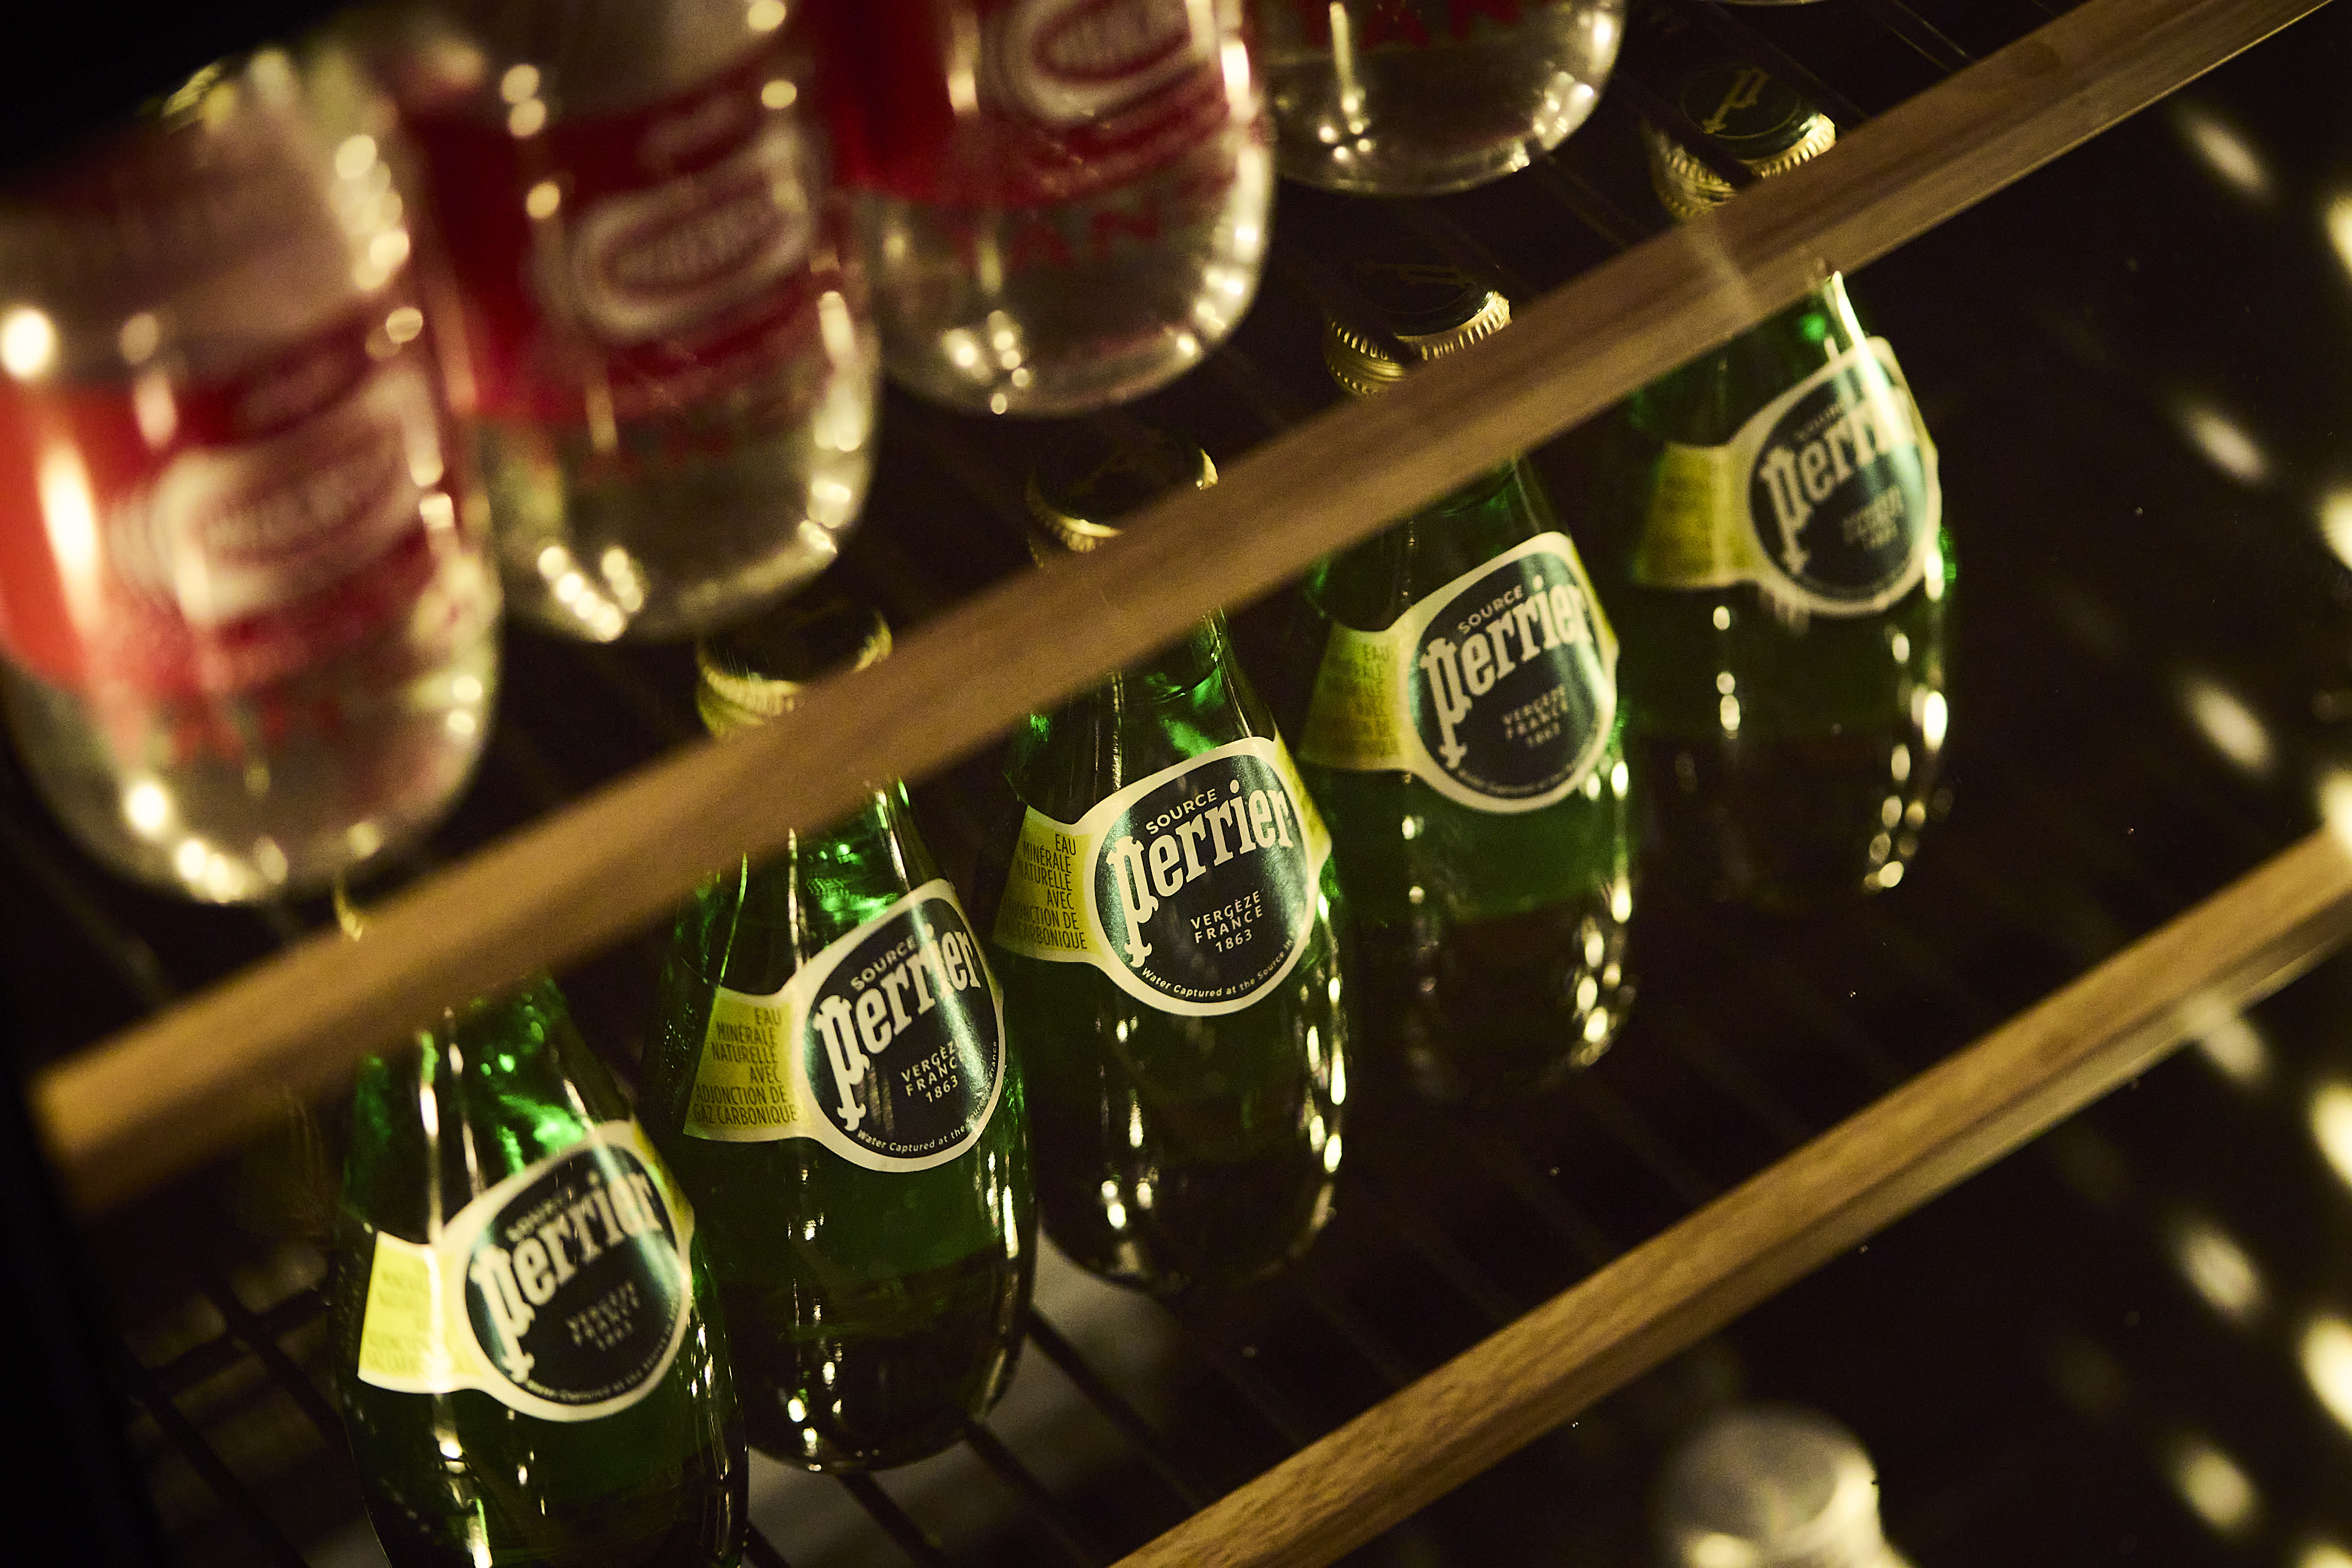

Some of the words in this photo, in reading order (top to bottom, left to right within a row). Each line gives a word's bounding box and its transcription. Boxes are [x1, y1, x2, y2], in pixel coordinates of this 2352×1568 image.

[1457, 584, 1523, 634] SOURCE
[1146, 788, 1218, 835] SOURCE
[1055, 834, 1076, 855] EAU
[1047, 889, 1074, 910] AVEC
[1190, 891, 1260, 929] VERGÈZE
[1063, 911, 1080, 929] DE
[1195, 905, 1263, 944] FRANCE
[1216, 929, 1252, 953] 1863
[850, 935, 916, 992] SOURCE
[1142, 967, 1172, 989] Water
[1174, 984, 1223, 997] Captured
[1226, 985, 1236, 995] at
[1239, 978, 1255, 991] the
[1257, 951, 1280, 980] Source
[769, 1085, 788, 1103] DE
[926, 1075, 958, 1103] 1863
[717, 1103, 799, 1125] CARBONIQUE
[857, 1129, 887, 1149] Water
[889, 1139, 935, 1154] Captured
[938, 1136, 948, 1145] at
[951, 1125, 965, 1139] the
